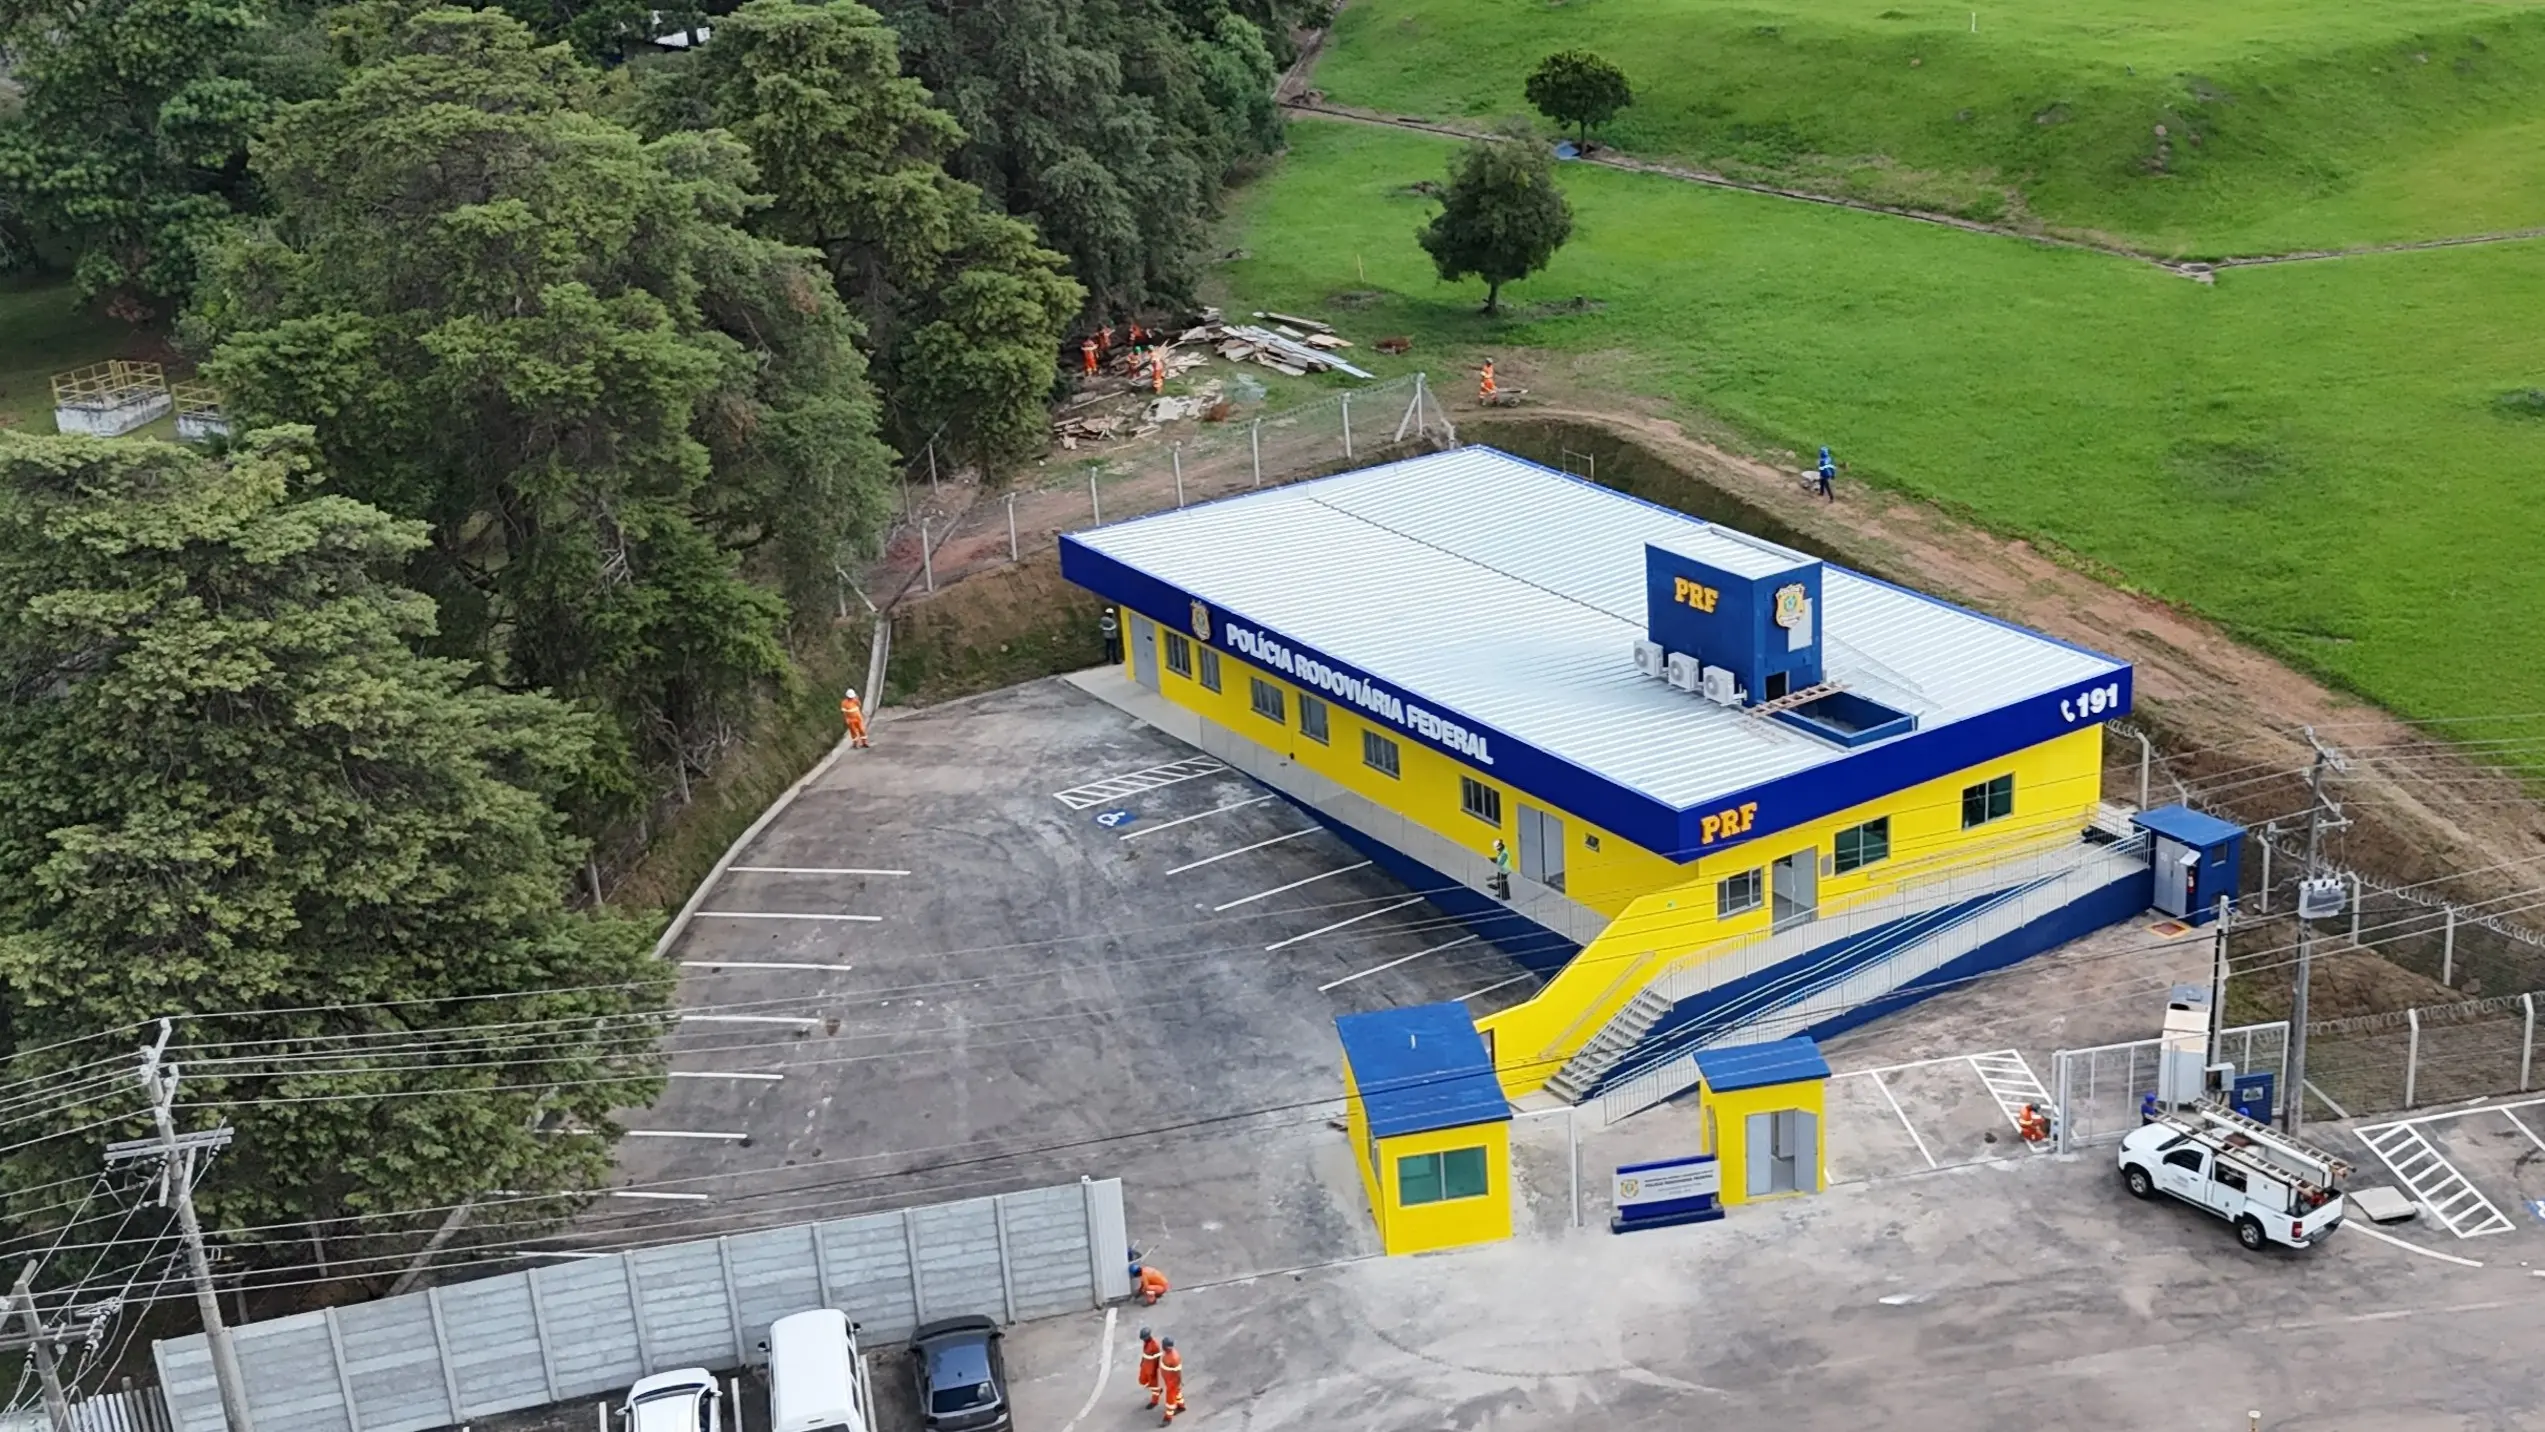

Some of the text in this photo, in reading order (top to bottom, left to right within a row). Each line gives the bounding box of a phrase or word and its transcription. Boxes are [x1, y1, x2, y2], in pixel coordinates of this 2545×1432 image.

[1674, 577, 1719, 613] PRF
[1226, 623, 1494, 765] POLÍCIA RODOVIÁRIA FEDERAL
[2076, 682, 2119, 718] 191
[1700, 802, 1758, 845] PRF
